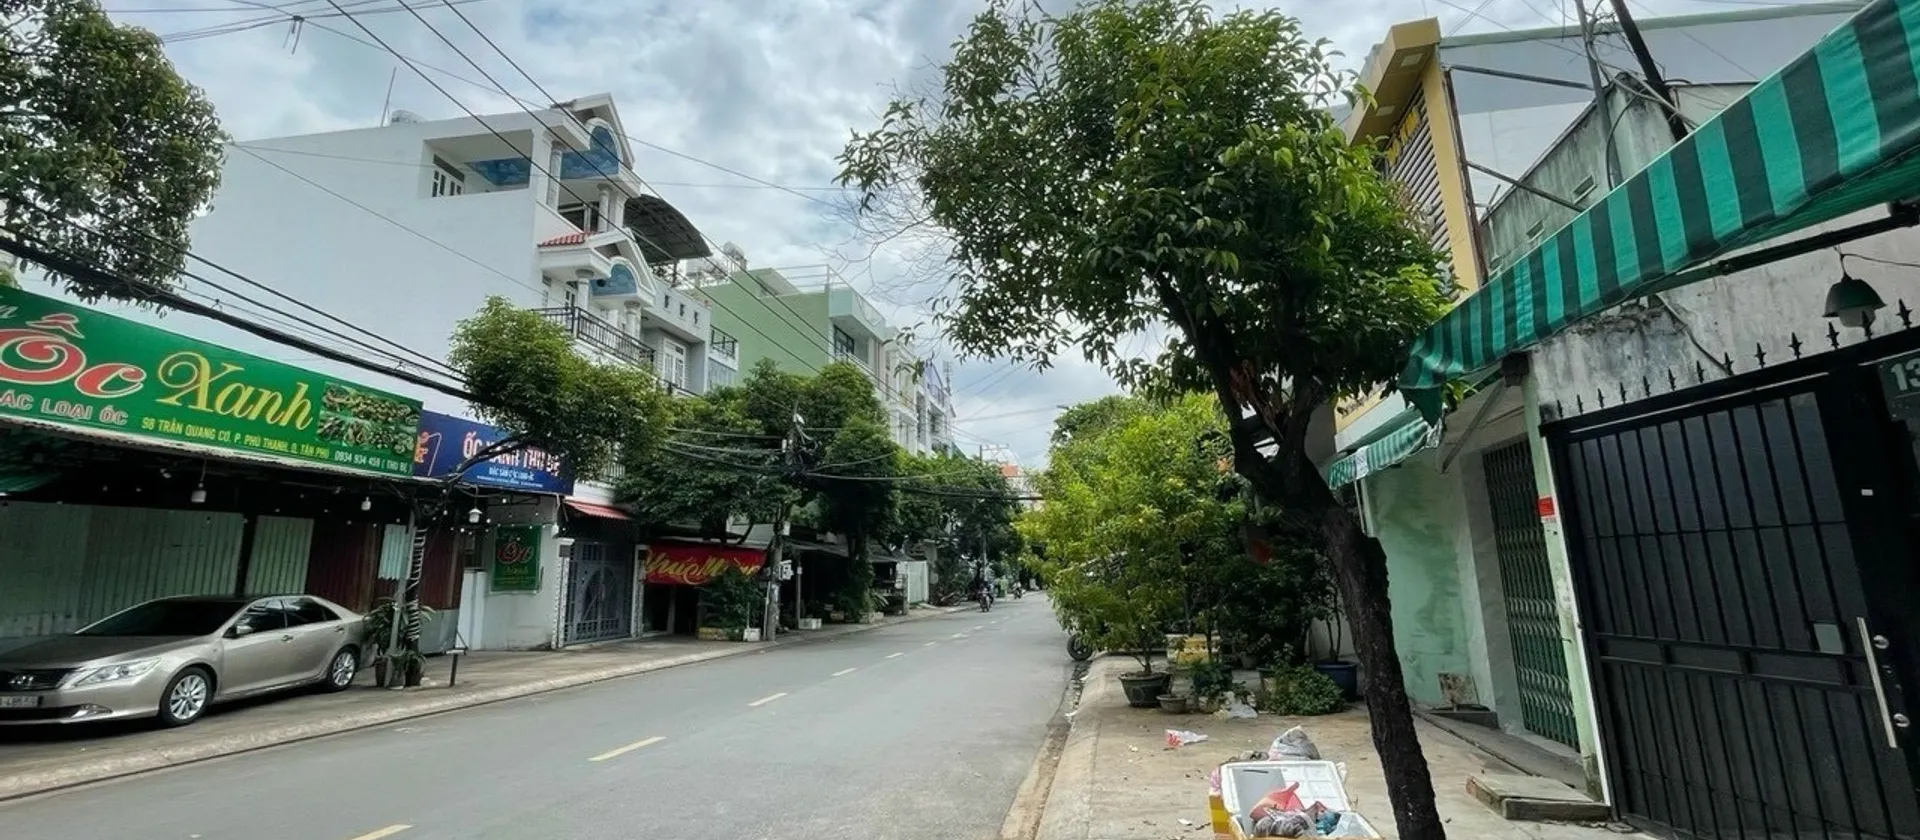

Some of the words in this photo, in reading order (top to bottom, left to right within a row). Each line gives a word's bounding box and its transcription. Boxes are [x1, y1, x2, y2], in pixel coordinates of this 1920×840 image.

[0, 313, 147, 399] Ốc
[155, 351, 314, 430] Xanh
[40, 397, 94, 420] LOẠI
[99, 405, 129, 425] ỐC
[185, 424, 216, 440] QUANG
[334, 450, 352, 462] 0934
[354, 454, 367, 465] 934
